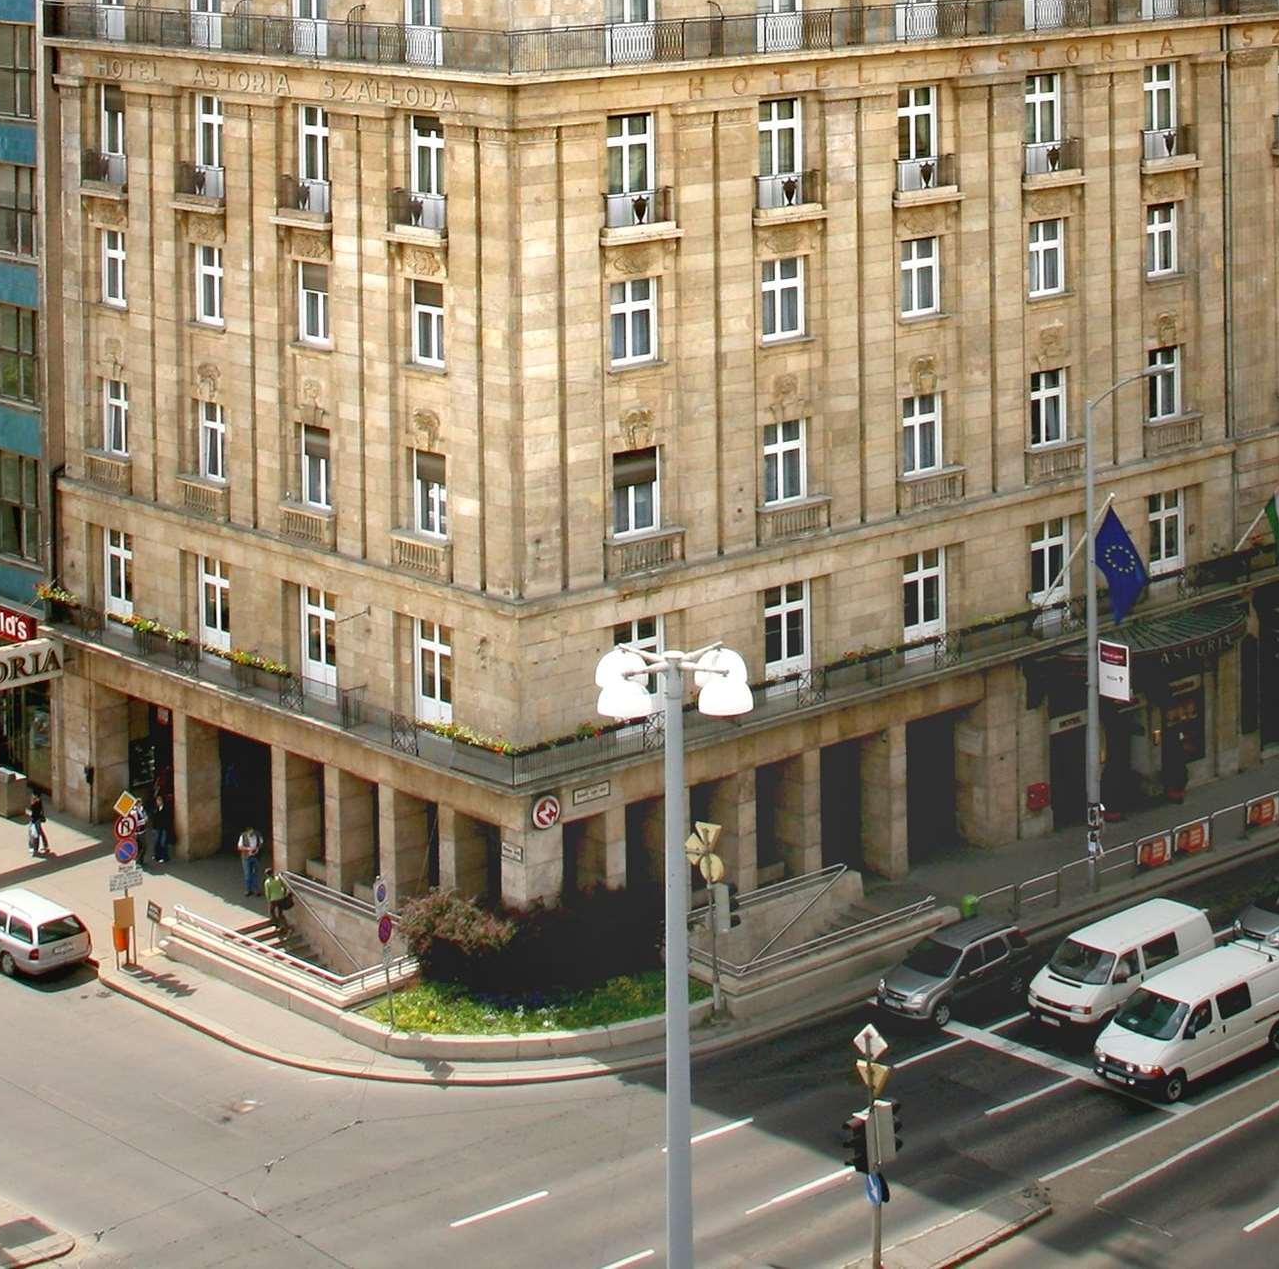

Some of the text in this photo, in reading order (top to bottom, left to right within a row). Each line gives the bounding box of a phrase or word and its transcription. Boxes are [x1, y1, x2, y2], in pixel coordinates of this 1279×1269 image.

[95, 57, 163, 81] HOTEL
[192, 65, 291, 94] ASTORIA
[688, 61, 871, 100] HOTEL
[958, 34, 1174, 74] ASTORIA
